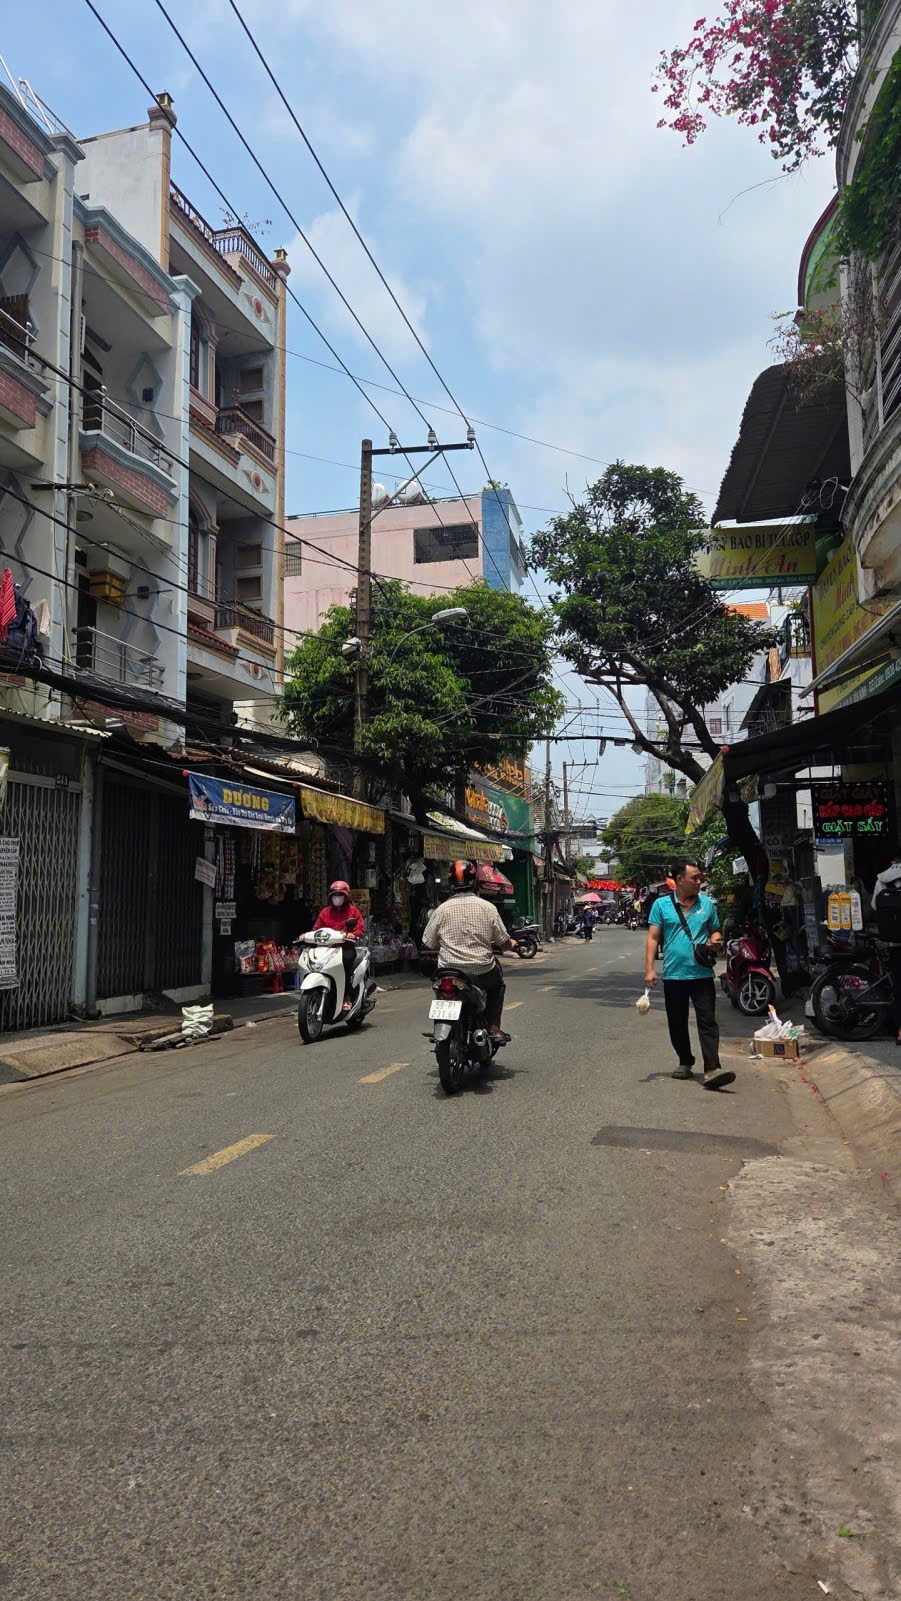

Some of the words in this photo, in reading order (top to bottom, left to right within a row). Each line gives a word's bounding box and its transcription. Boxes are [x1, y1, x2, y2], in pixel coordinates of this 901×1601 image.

[730, 535, 753, 550] BAO
[223, 788, 270, 812] DƯƠNG
[822, 818, 853, 835] GIẶT
[857, 816, 884, 833] SẤY
